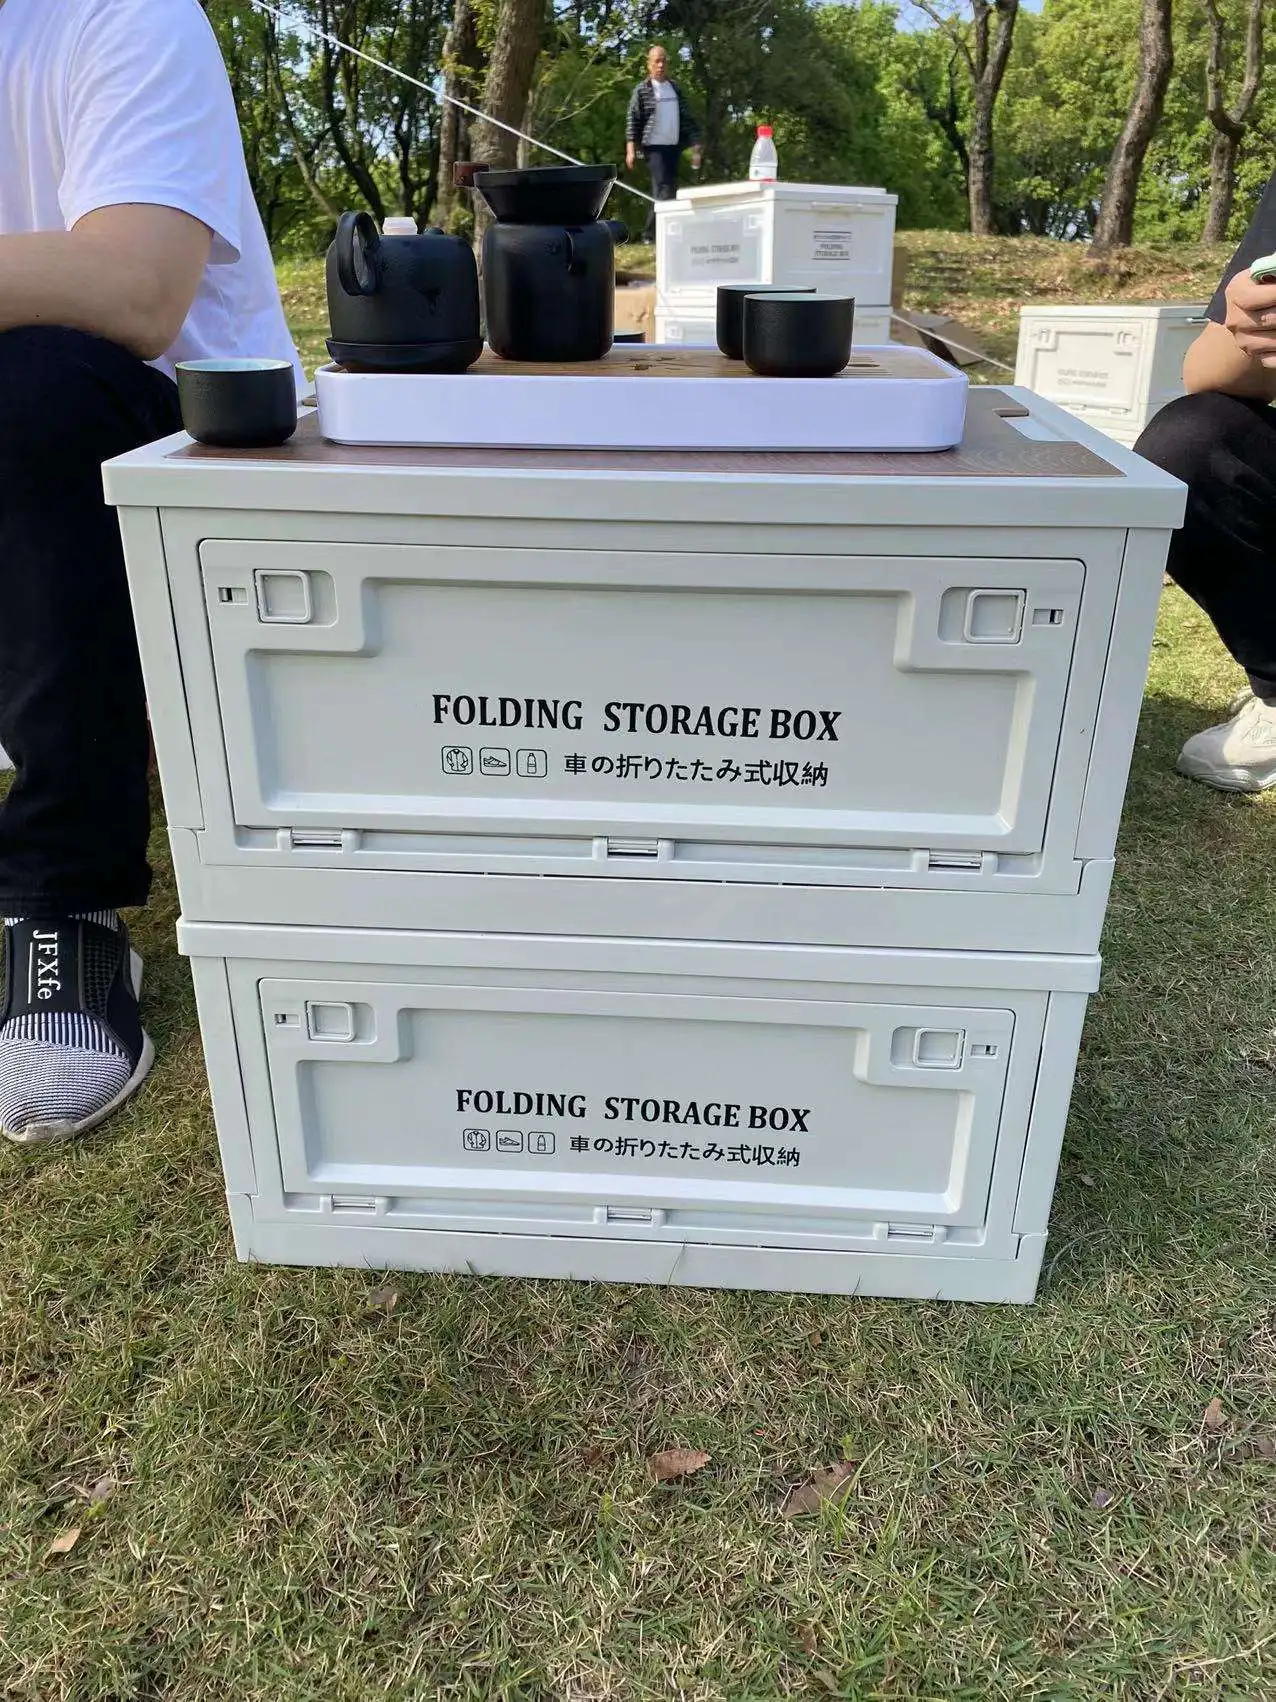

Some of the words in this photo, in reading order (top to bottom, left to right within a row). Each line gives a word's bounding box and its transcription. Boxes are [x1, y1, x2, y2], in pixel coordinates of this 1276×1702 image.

[432, 694, 584, 730] FOLDING
[603, 701, 762, 738] STORAGE
[768, 708, 842, 742] BOX
[563, 752, 829, 787] 車の折りたたみ式収納
[32, 929, 62, 1000] JFXfe
[456, 1089, 587, 1118] FOLDING
[604, 1096, 741, 1128] STORAGE
[747, 1105, 811, 1133] BOX
[569, 1134, 801, 1168] 車の折りたたみ式収納
